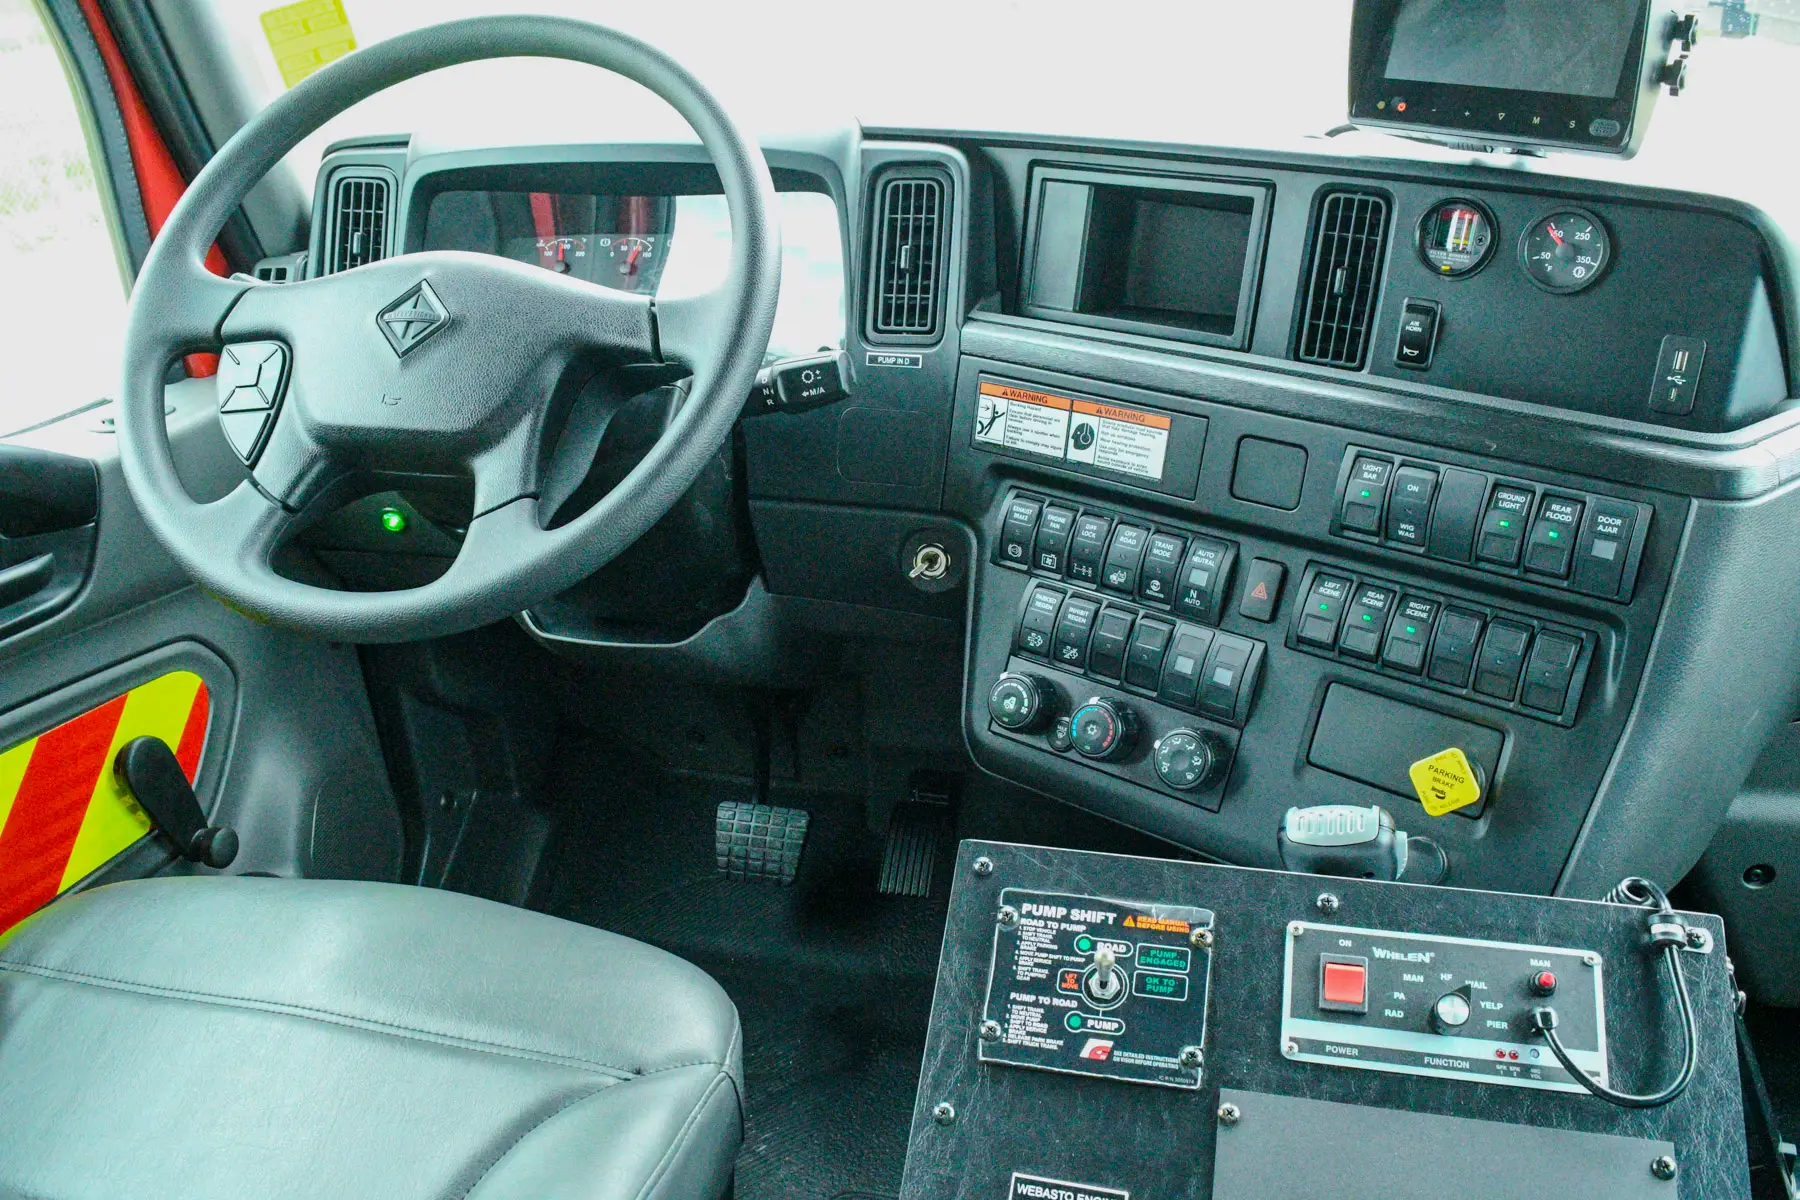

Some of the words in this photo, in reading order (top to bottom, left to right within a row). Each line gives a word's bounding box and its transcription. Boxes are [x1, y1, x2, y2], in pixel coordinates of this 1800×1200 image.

[1532, 116, 1541, 125] M
[1569, 120, 1576, 128] S
[1574, 232, 1590, 240] 250
[1576, 256, 1591, 264] 350
[1406, 325, 1422, 333] HORN
[809, 386, 826, 396] M/A
[1010, 390, 1048, 404] WARNING
[1104, 408, 1145, 422] WARNING
[1362, 464, 1383, 474] LIGHT
[1362, 471, 1377, 481] BAR
[1407, 484, 1419, 493] ON
[1498, 492, 1526, 503] GROUND
[1013, 505, 1033, 515] EXHAUST
[1499, 500, 1521, 510] LIGHT
[1551, 504, 1572, 514] REAR
[1013, 512, 1028, 521] BRAKE
[1047, 514, 1066, 524] ENGINE
[1546, 512, 1572, 523] FLOOD
[1598, 515, 1622, 526] DOOR
[1049, 521, 1060, 530] FAN
[1400, 523, 1414, 532] WIG
[1598, 524, 1618, 535] AJAR
[1082, 529, 1096, 538] LOCK
[1125, 530, 1137, 539] OFF
[1398, 530, 1415, 539] WAG
[1119, 536, 1136, 545] ROAD
[1155, 540, 1174, 550] TRANS
[1152, 548, 1171, 558] MODE
[1198, 550, 1214, 559] AUTO
[1192, 556, 1215, 567] NEUTRAL
[1324, 580, 1341, 590] LEFT
[1190, 589, 1197, 598] N
[1318, 586, 1341, 597] SCENE
[1366, 590, 1385, 600] REAR
[1035, 593, 1057, 604] PARKED
[1184, 597, 1200, 606] AUTO
[1362, 597, 1384, 608] SCENE
[1034, 600, 1053, 611] REGEN
[1408, 601, 1431, 612] RIGHT
[1068, 607, 1089, 618] INHIBIT
[1405, 608, 1429, 619] SCENE
[1067, 614, 1087, 624] REGEN
[1428, 764, 1464, 784] PARKING
[1432, 776, 1455, 789] BRAKE
[1022, 903, 1067, 918] PUMP
[1070, 909, 1117, 925] SHIFT
[1020, 918, 1045, 928] ROAD
[1047, 921, 1059, 929] TO
[1060, 923, 1086, 932] PUMP
[1158, 918, 1189, 927] MANUAL
[1136, 922, 1166, 932] BEFORE
[1167, 925, 1190, 934] USING
[1097, 942, 1127, 953] ROAD
[1338, 939, 1352, 947] ON
[1150, 950, 1177, 958] PUMP
[1140, 956, 1186, 967] ENGAGED
[1530, 958, 1551, 968] MAN
[1162, 978, 1175, 986] TO
[1403, 973, 1424, 983] MAN
[1146, 984, 1174, 994] PUMP
[1465, 980, 1488, 989] WAIL
[1010, 992, 1036, 1003] PUMP
[1038, 996, 1050, 1005] TO
[1052, 997, 1078, 1008] ROAD
[1394, 992, 1406, 1000] PA
[1480, 1001, 1503, 1010] YELP
[1384, 1009, 1404, 1018] RAD
[1087, 1019, 1118, 1031] PUMP
[1487, 1020, 1508, 1029] PIER
[1326, 1045, 1358, 1056] POWER
[1424, 1057, 1470, 1069] FUNCTION
[1016, 1183, 1074, 1200] WEBASTO
